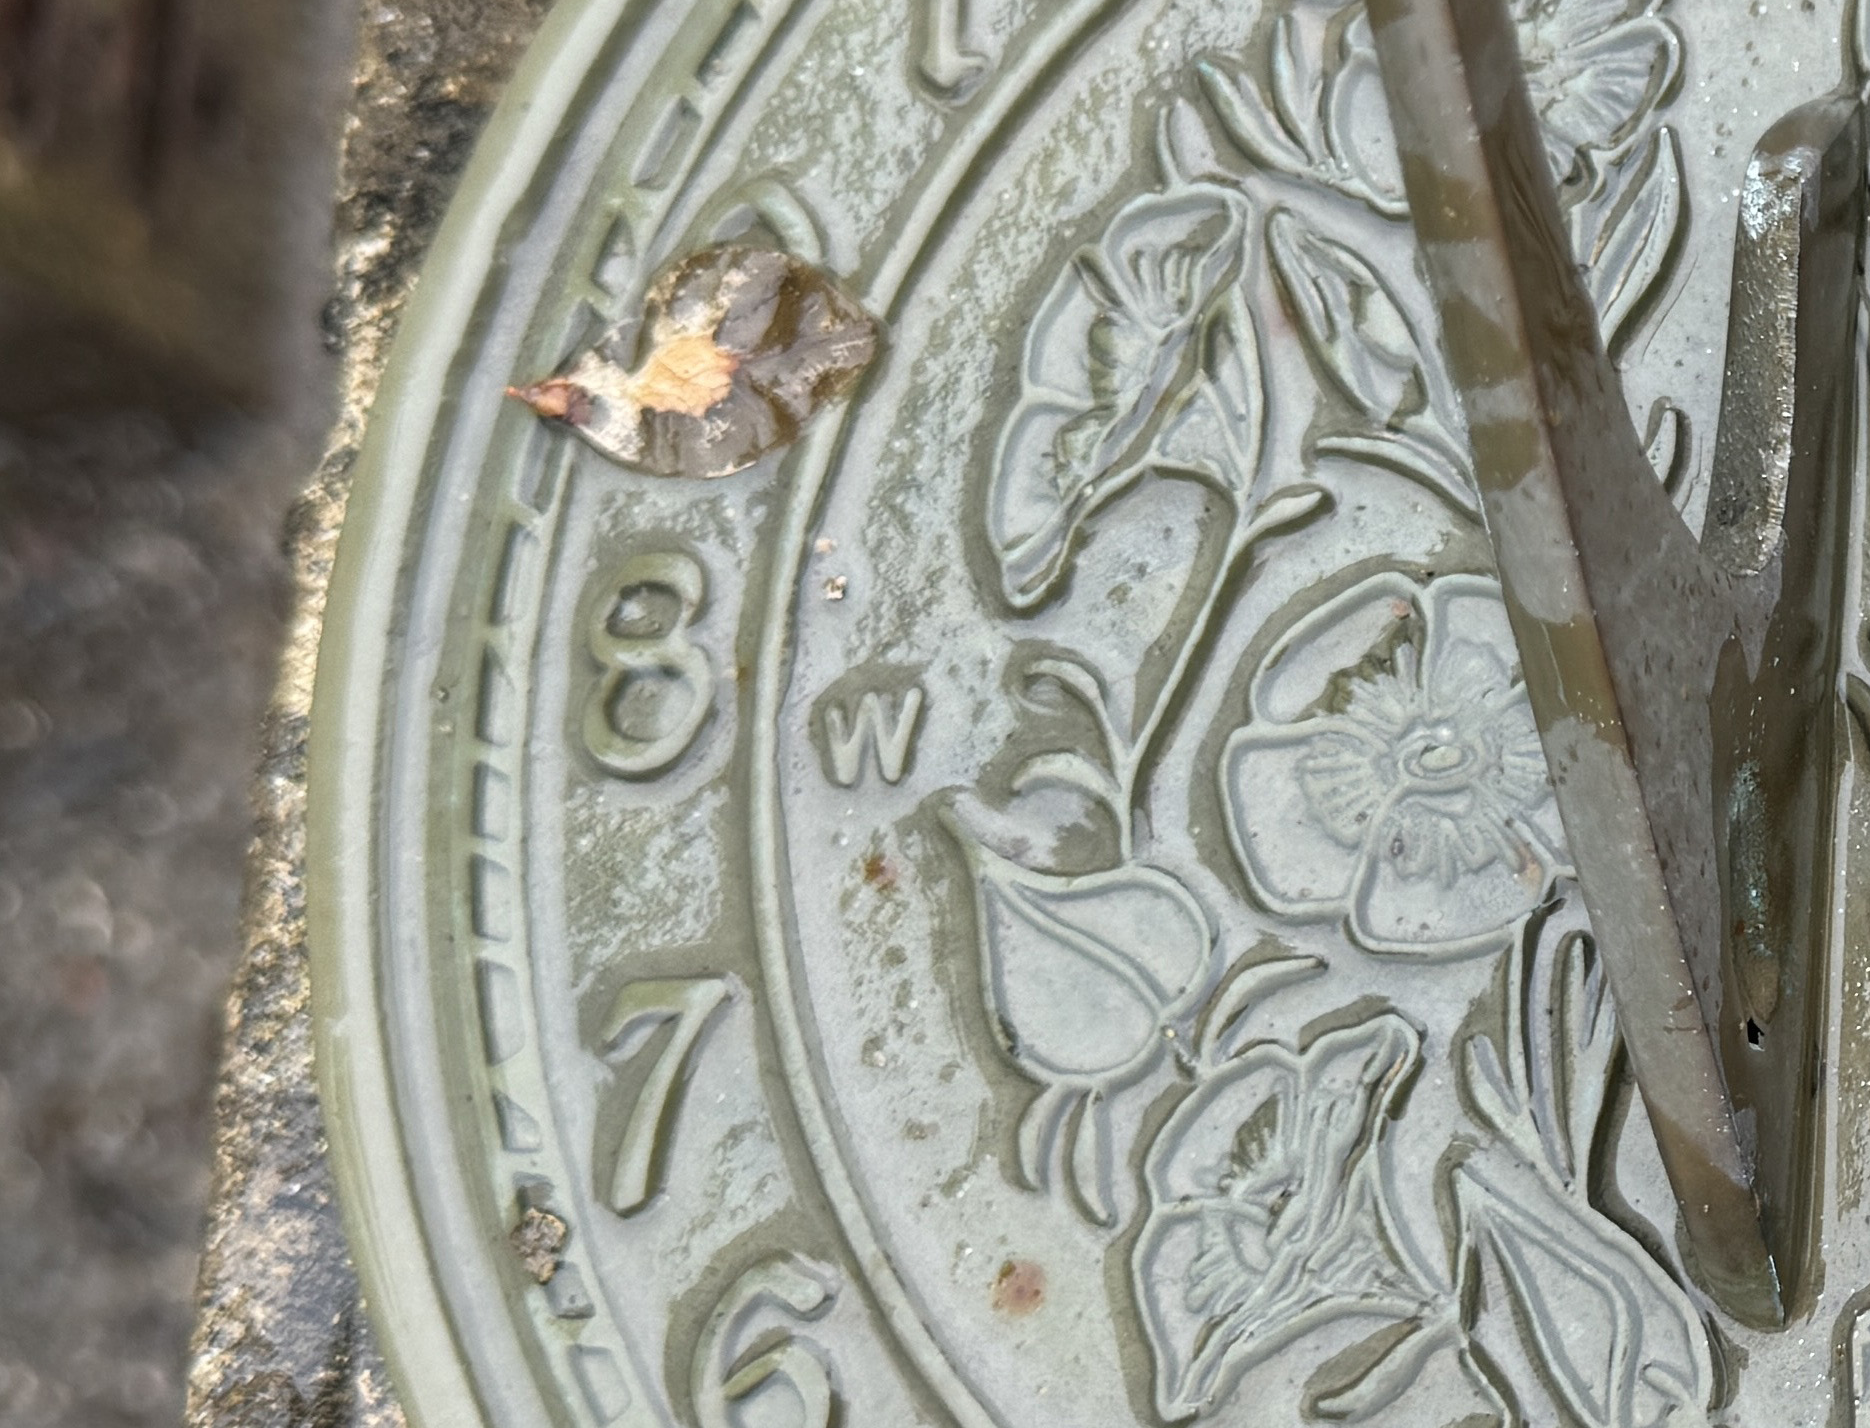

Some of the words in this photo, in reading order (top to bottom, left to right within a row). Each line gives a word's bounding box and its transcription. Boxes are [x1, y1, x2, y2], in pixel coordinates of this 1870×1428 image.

[582, 550, 714, 782] 8
[820, 684, 925, 789] W
[604, 974, 738, 1220] 7
